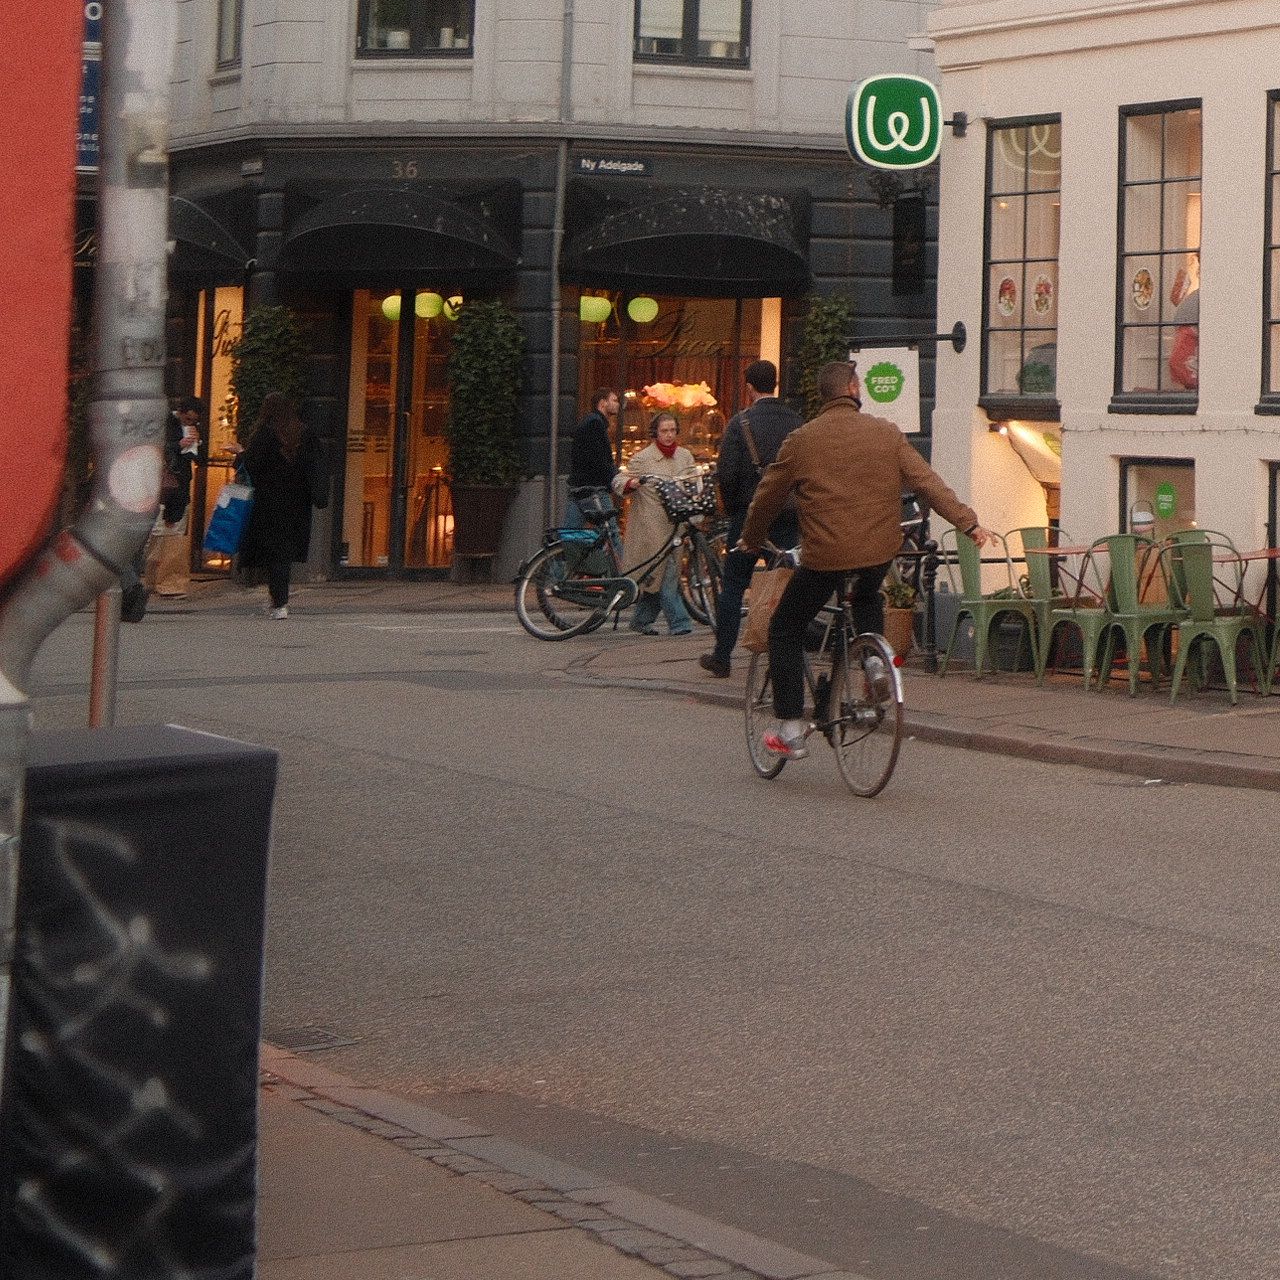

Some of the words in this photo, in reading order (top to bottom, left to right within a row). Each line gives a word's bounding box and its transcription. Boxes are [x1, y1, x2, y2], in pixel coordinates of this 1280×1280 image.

[392, 160, 419, 180] 36
[581, 159, 597, 171] Ny
[598, 160, 645, 173] Adelgade
[872, 376, 898, 384] FRED
